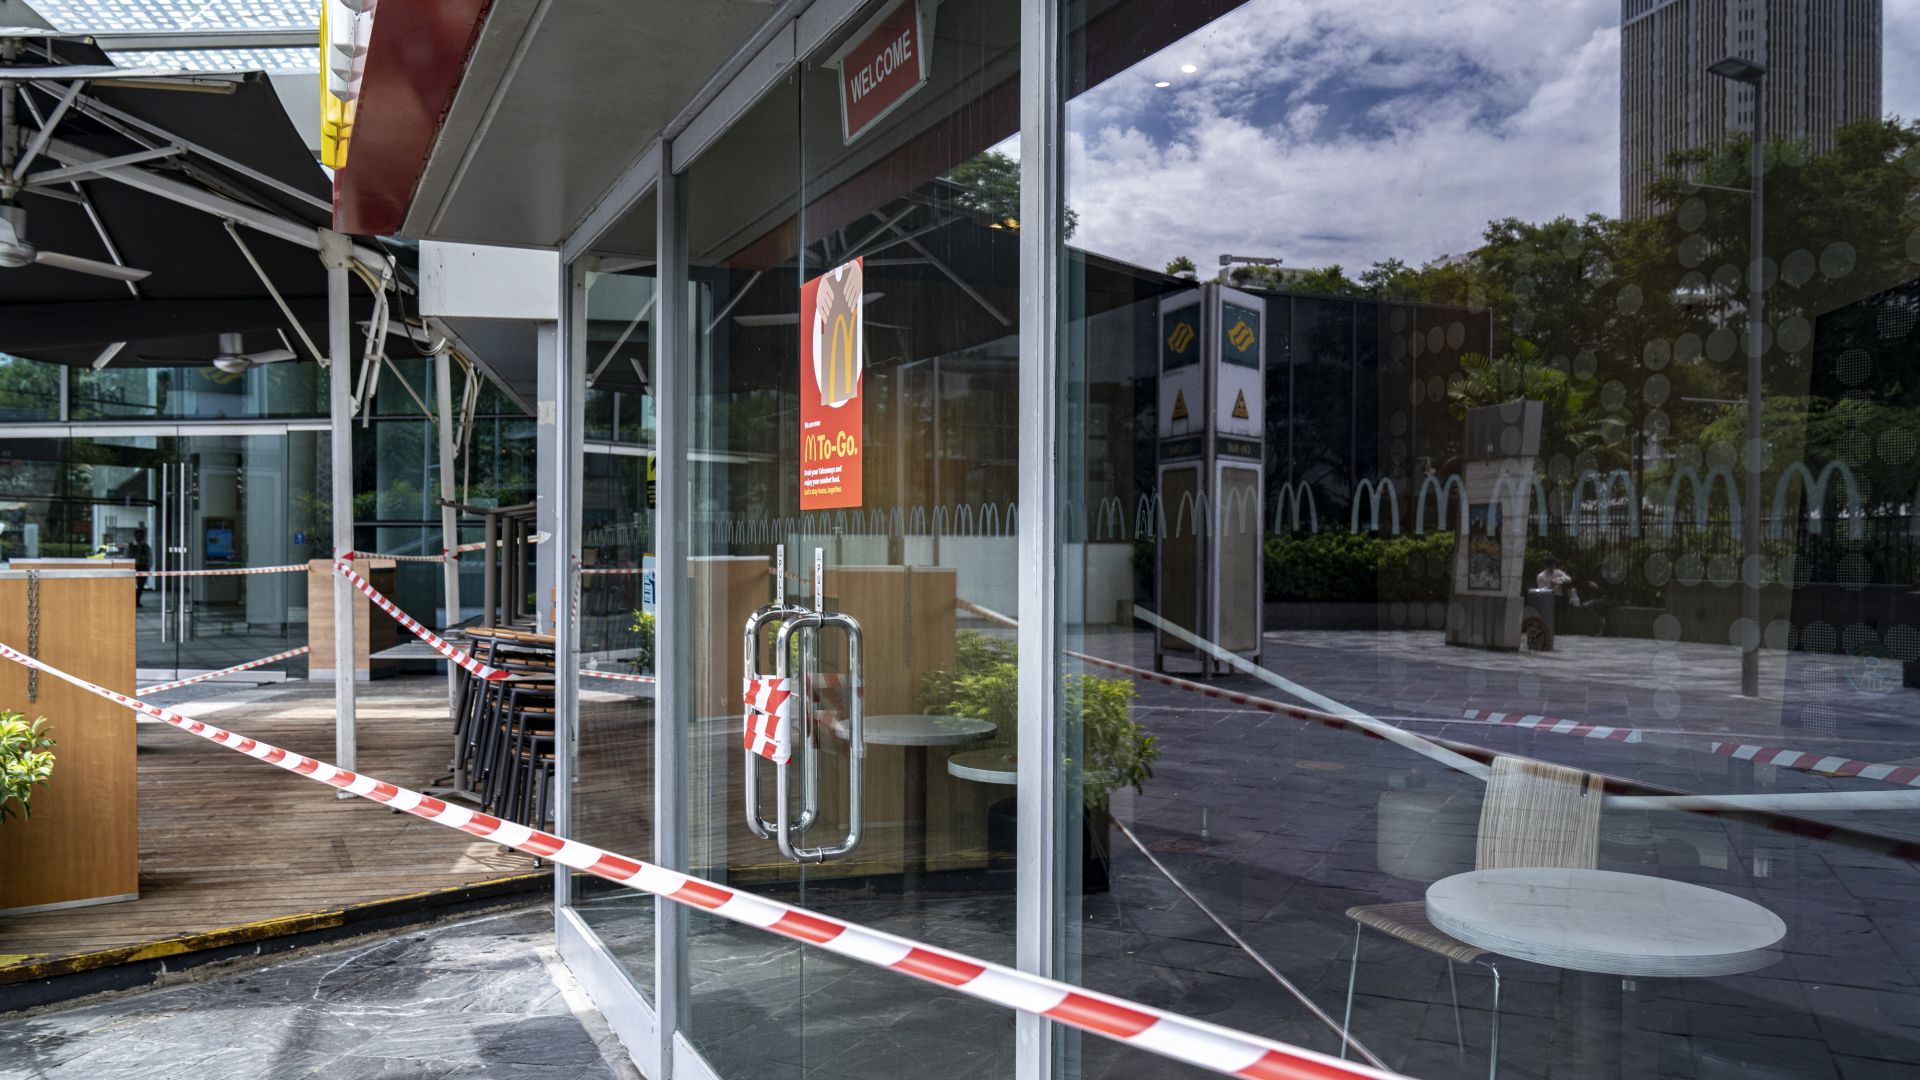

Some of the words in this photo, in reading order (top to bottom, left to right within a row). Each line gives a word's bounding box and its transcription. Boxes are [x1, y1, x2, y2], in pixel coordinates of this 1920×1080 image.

[850, 29, 912, 103] WELCOME
[817, 430, 858, 460] To-Go.
[804, 478, 813, 487] enjoy
[812, 479, 820, 487] your
[819, 476, 832, 484] comfort
[831, 475, 841, 483] food.
[811, 469, 819, 477] your
[835, 464, 843, 473] and
